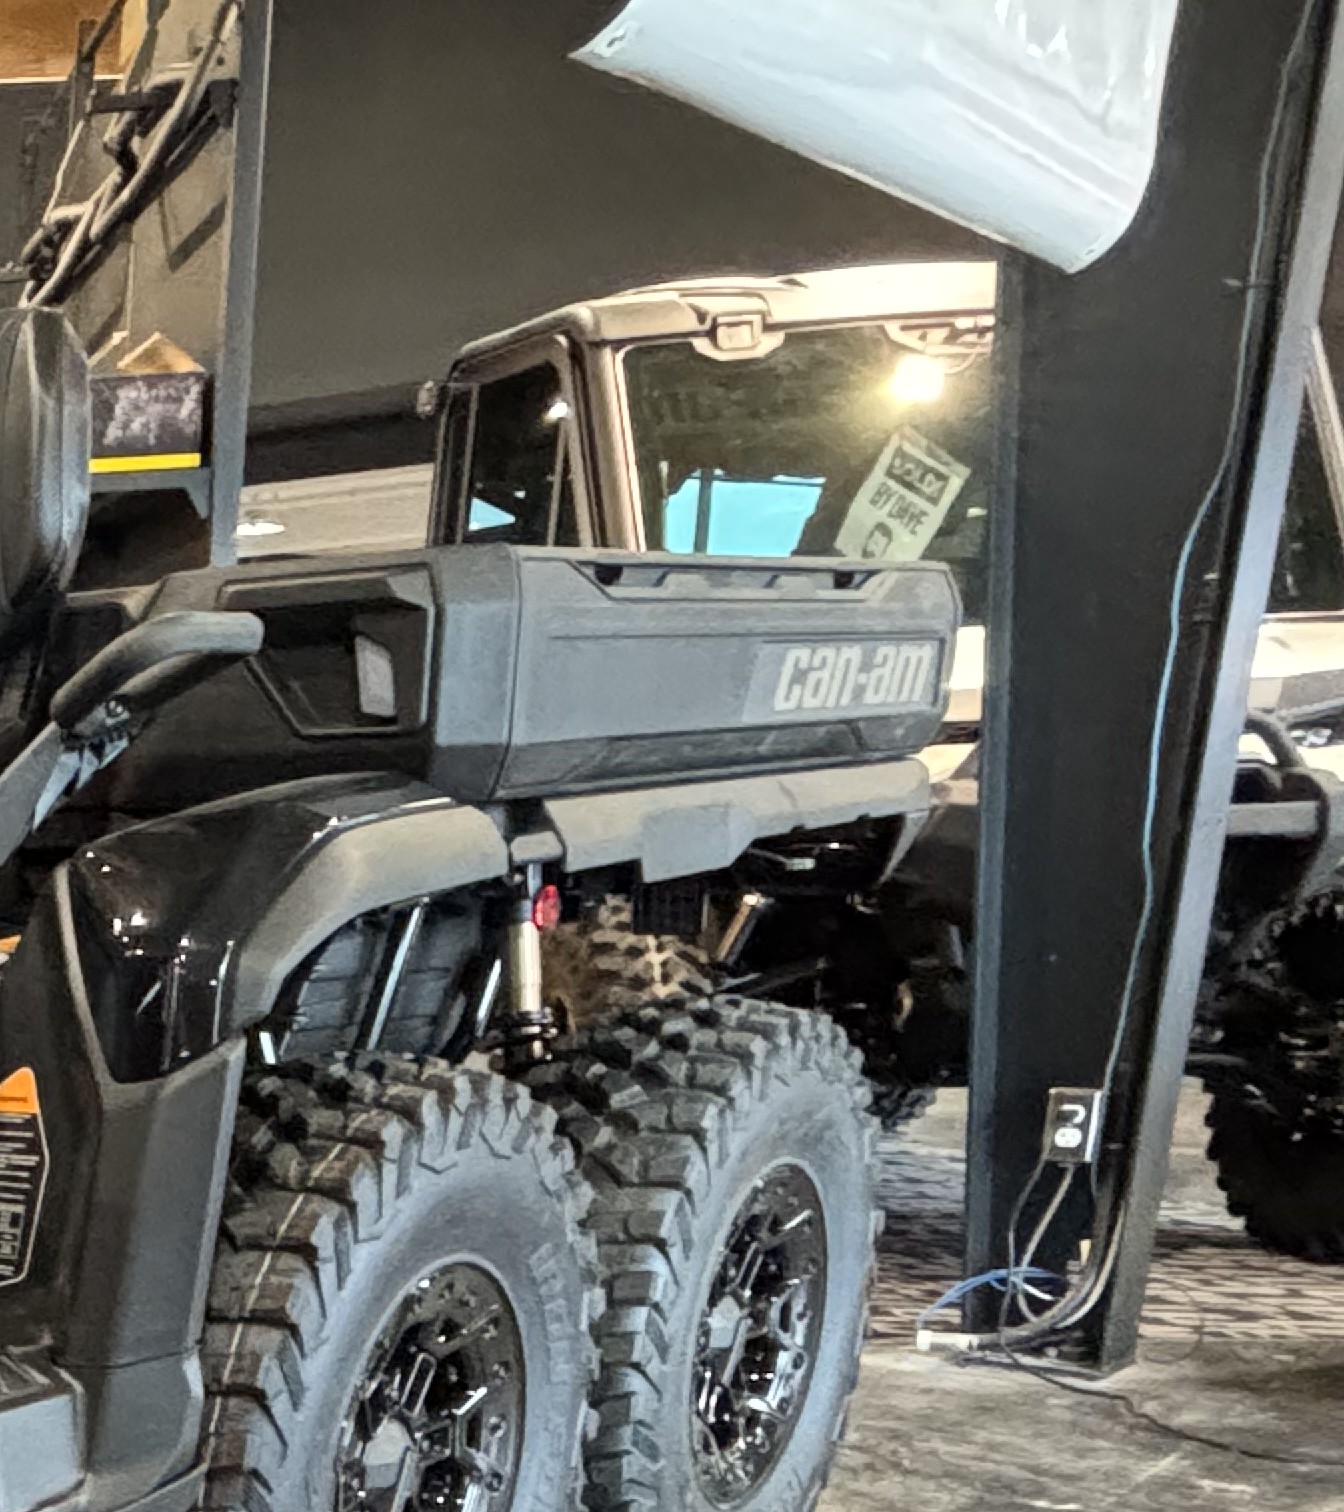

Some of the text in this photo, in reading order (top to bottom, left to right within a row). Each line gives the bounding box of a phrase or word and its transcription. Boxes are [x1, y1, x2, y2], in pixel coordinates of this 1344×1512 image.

[869, 482, 930, 535] BY DAVE
[774, 643, 932, 711] can-am
